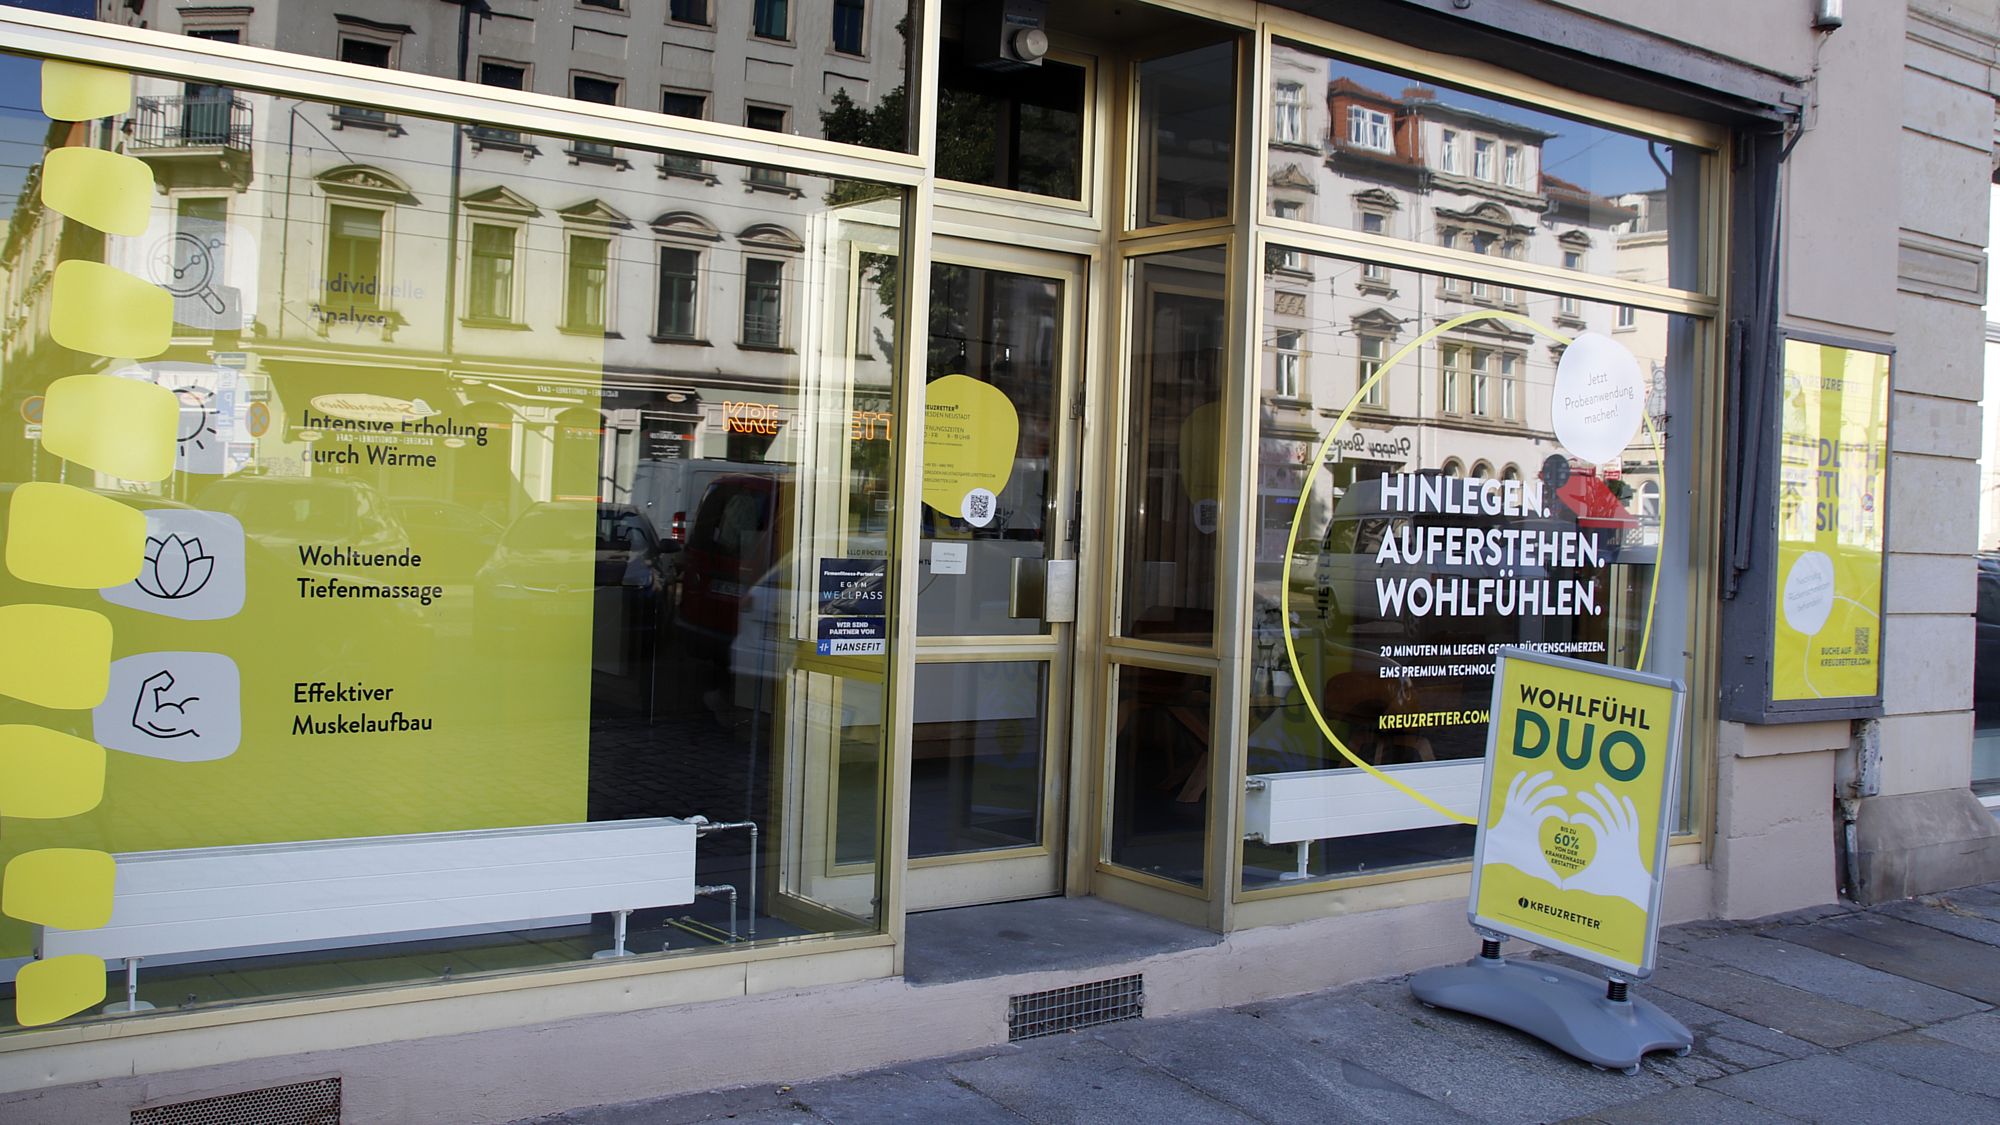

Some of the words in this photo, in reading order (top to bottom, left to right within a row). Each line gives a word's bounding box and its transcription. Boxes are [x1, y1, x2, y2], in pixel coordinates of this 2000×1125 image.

[310, 271, 424, 299] Individuelle
[306, 303, 388, 334] Analyse
[1588, 372, 1608, 386] Jetzt
[1564, 385, 1634, 410] Probeanwendung
[1584, 404, 1619, 424] machen!
[303, 410, 394, 434] Intensive
[401, 415, 488, 447] Erholung
[301, 444, 359, 465] durch
[366, 444, 437, 468] Wärme
[1380, 472, 1551, 518] HINLEGEN.
[298, 545, 422, 567] Wohltuende
[1375, 525, 1605, 568] AUFERSTEHEN.
[297, 577, 443, 606] Tiefenmassage
[823, 591, 883, 600] WELLPASS
[1317, 573, 1330, 619] HIER
[1375, 568, 1602, 617] WOHLFÜHLEN.
[835, 642, 881, 652] HANSEFIT
[1380, 645, 1392, 657] 20
[1393, 644, 1438, 656] MINUTEN
[1440, 644, 1452, 656] IM
[1453, 644, 1485, 655] LIEGEN
[1821, 647, 1840, 656] BUCHE
[1840, 646, 1852, 655] AUF
[1379, 666, 1400, 678] EMS
[1401, 665, 1446, 678] PREMIUM
[1820, 657, 1871, 667] KREUZRETTER.COM
[293, 682, 394, 703] Effektiver
[1520, 684, 1650, 731] WOHLFÜHL
[292, 712, 432, 735] Muskelaufbau
[1378, 710, 1490, 730] KREUZRETTER.COM
[1512, 708, 1646, 782] DUO
[1554, 833, 1579, 850] 60%
[1545, 850, 1586, 866] KRANKENKASSE
